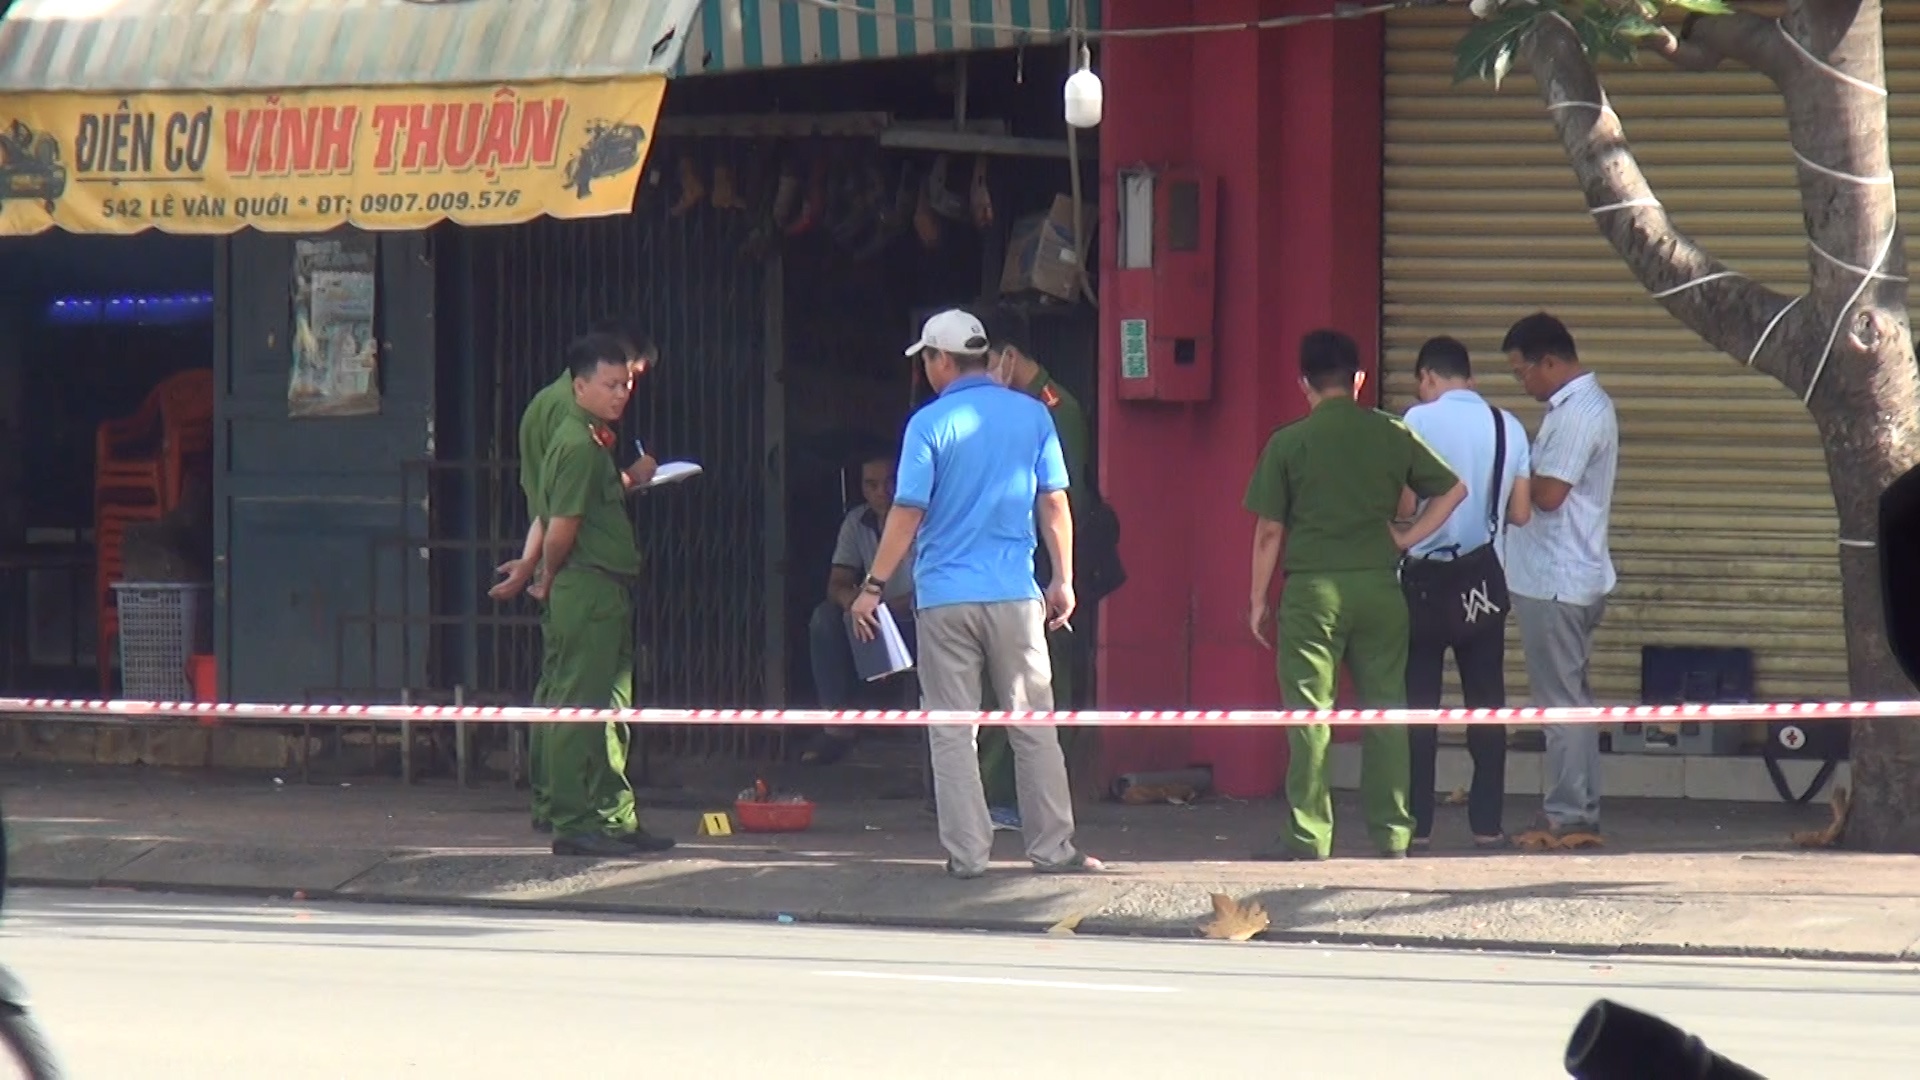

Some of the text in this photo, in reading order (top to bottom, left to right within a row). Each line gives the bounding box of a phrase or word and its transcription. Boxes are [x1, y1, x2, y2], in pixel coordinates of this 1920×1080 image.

[75, 84, 566, 185] ĐIỆN CƠ VĨNH THUẬN
[102, 198, 142, 218] 542
[150, 193, 175, 217] LÊ
[316, 195, 352, 214] ĐT:
[360, 188, 521, 214] 0907.009.576
[713, 815, 722, 830] 1
